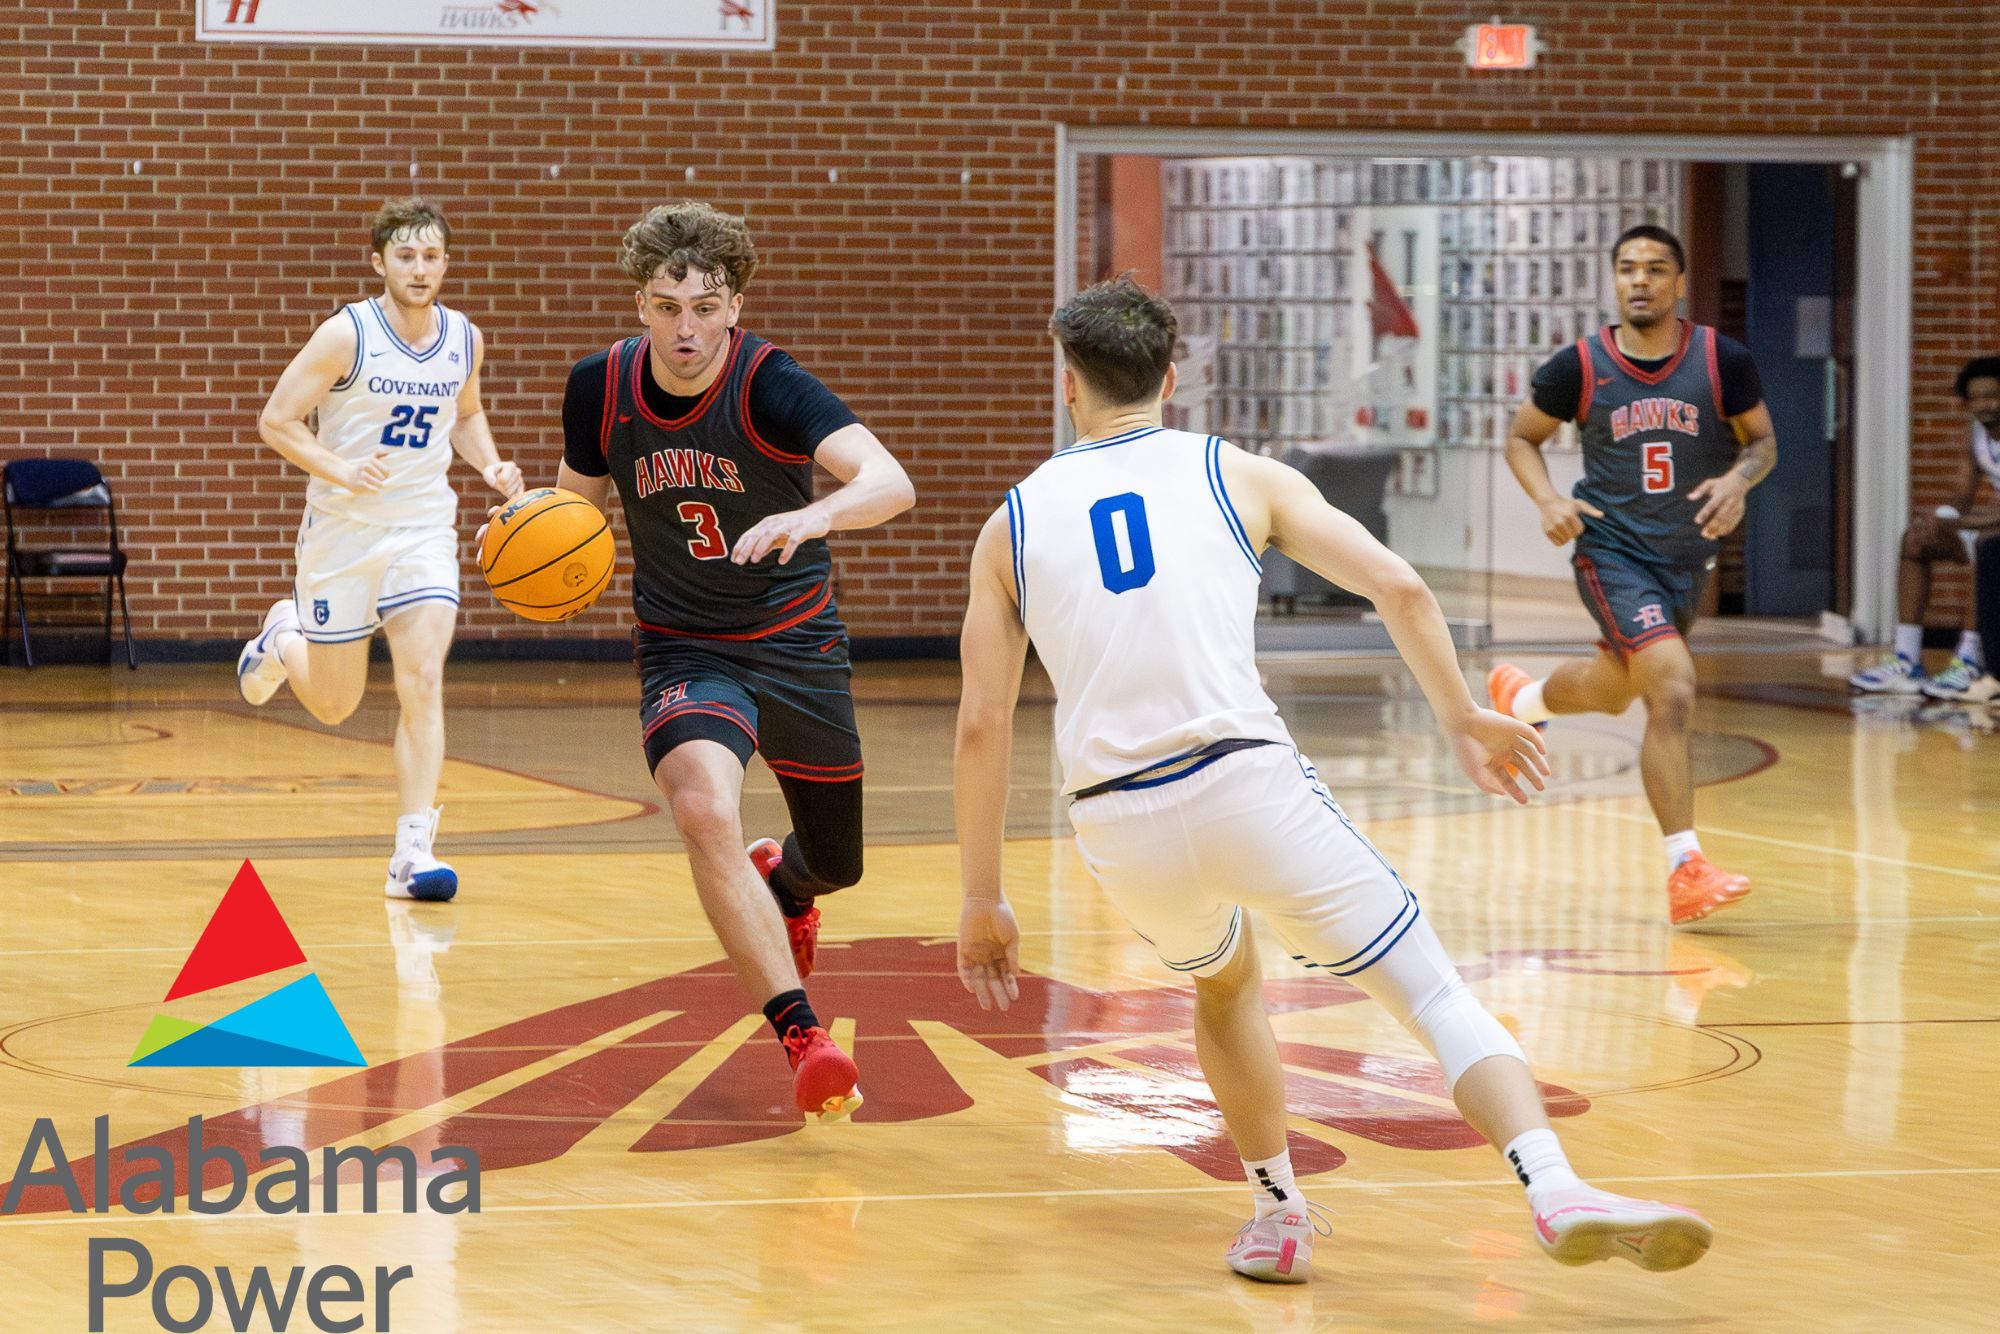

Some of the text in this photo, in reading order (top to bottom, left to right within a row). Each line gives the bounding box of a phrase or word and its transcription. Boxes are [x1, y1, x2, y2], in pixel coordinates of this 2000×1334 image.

[368, 376, 459, 397] COVENANT
[381, 404, 439, 448] 25
[1611, 398, 1700, 441] HAWKS
[634, 449, 745, 498] HAWKS
[1642, 441, 1674, 493] 5
[677, 502, 728, 560] 3
[1089, 492, 1156, 595] 0
